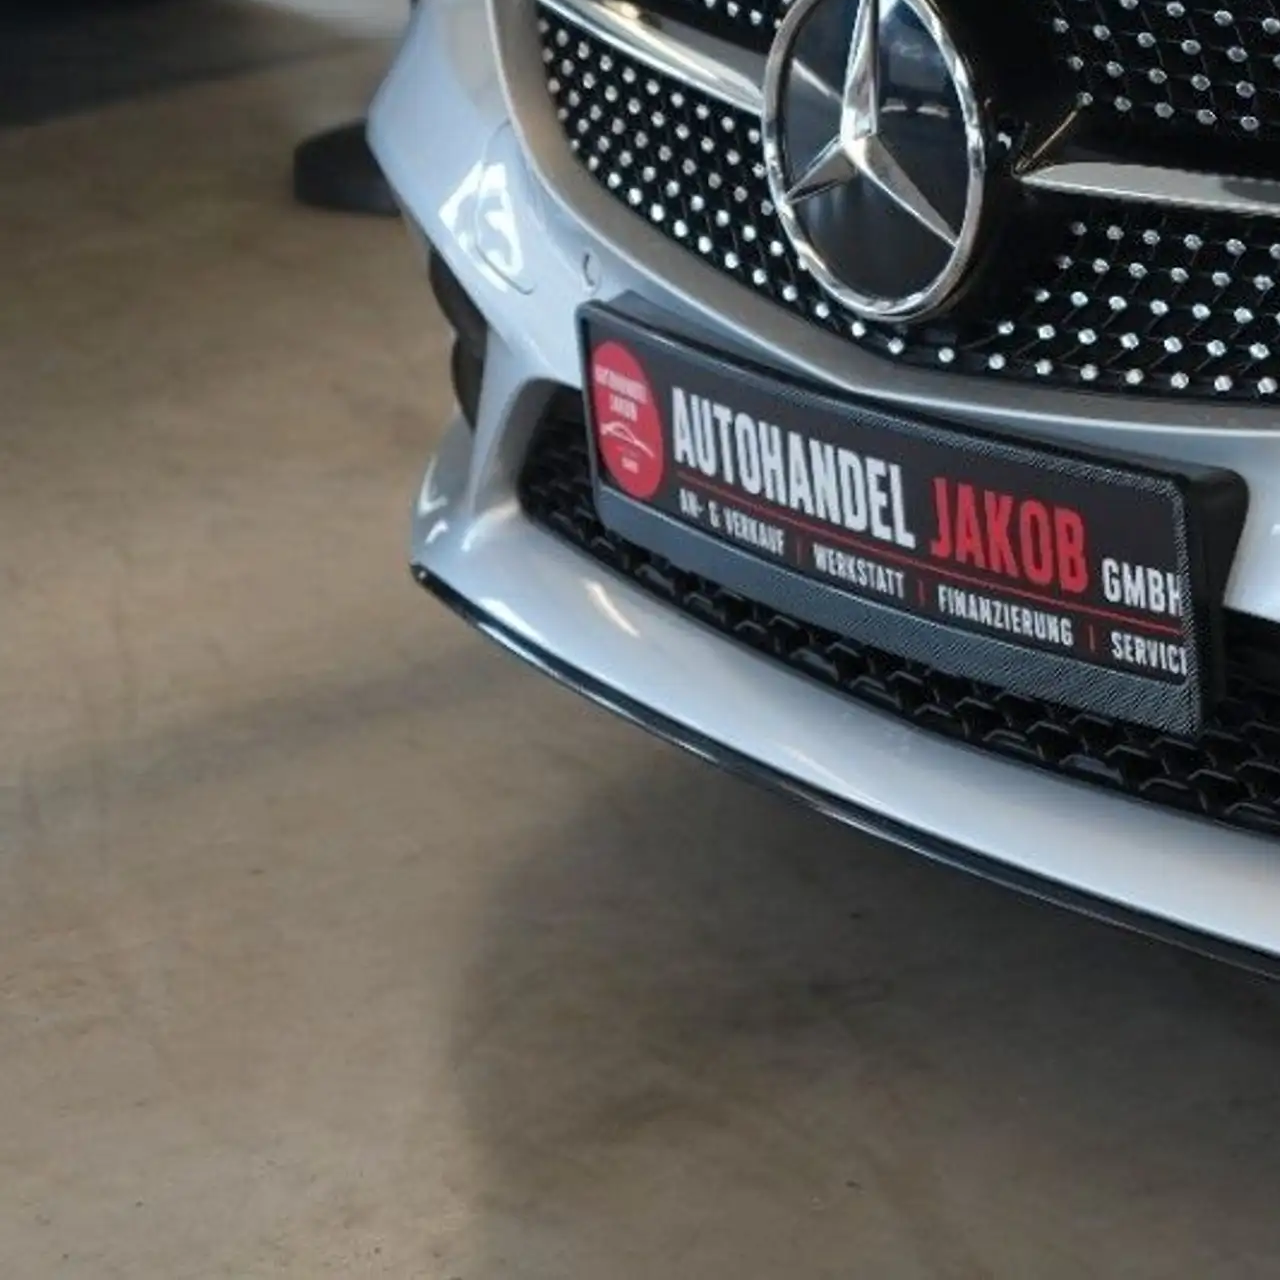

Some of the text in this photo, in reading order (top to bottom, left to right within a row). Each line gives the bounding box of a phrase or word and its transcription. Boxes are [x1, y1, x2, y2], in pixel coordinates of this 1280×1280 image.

[672, 387, 1182, 616] AUTOHANDEL JAKOB GMBH
[723, 506, 784, 556] VERKAUF
[813, 543, 904, 599] WERKSTATT
[938, 584, 1074, 646] FINANZIERUNG
